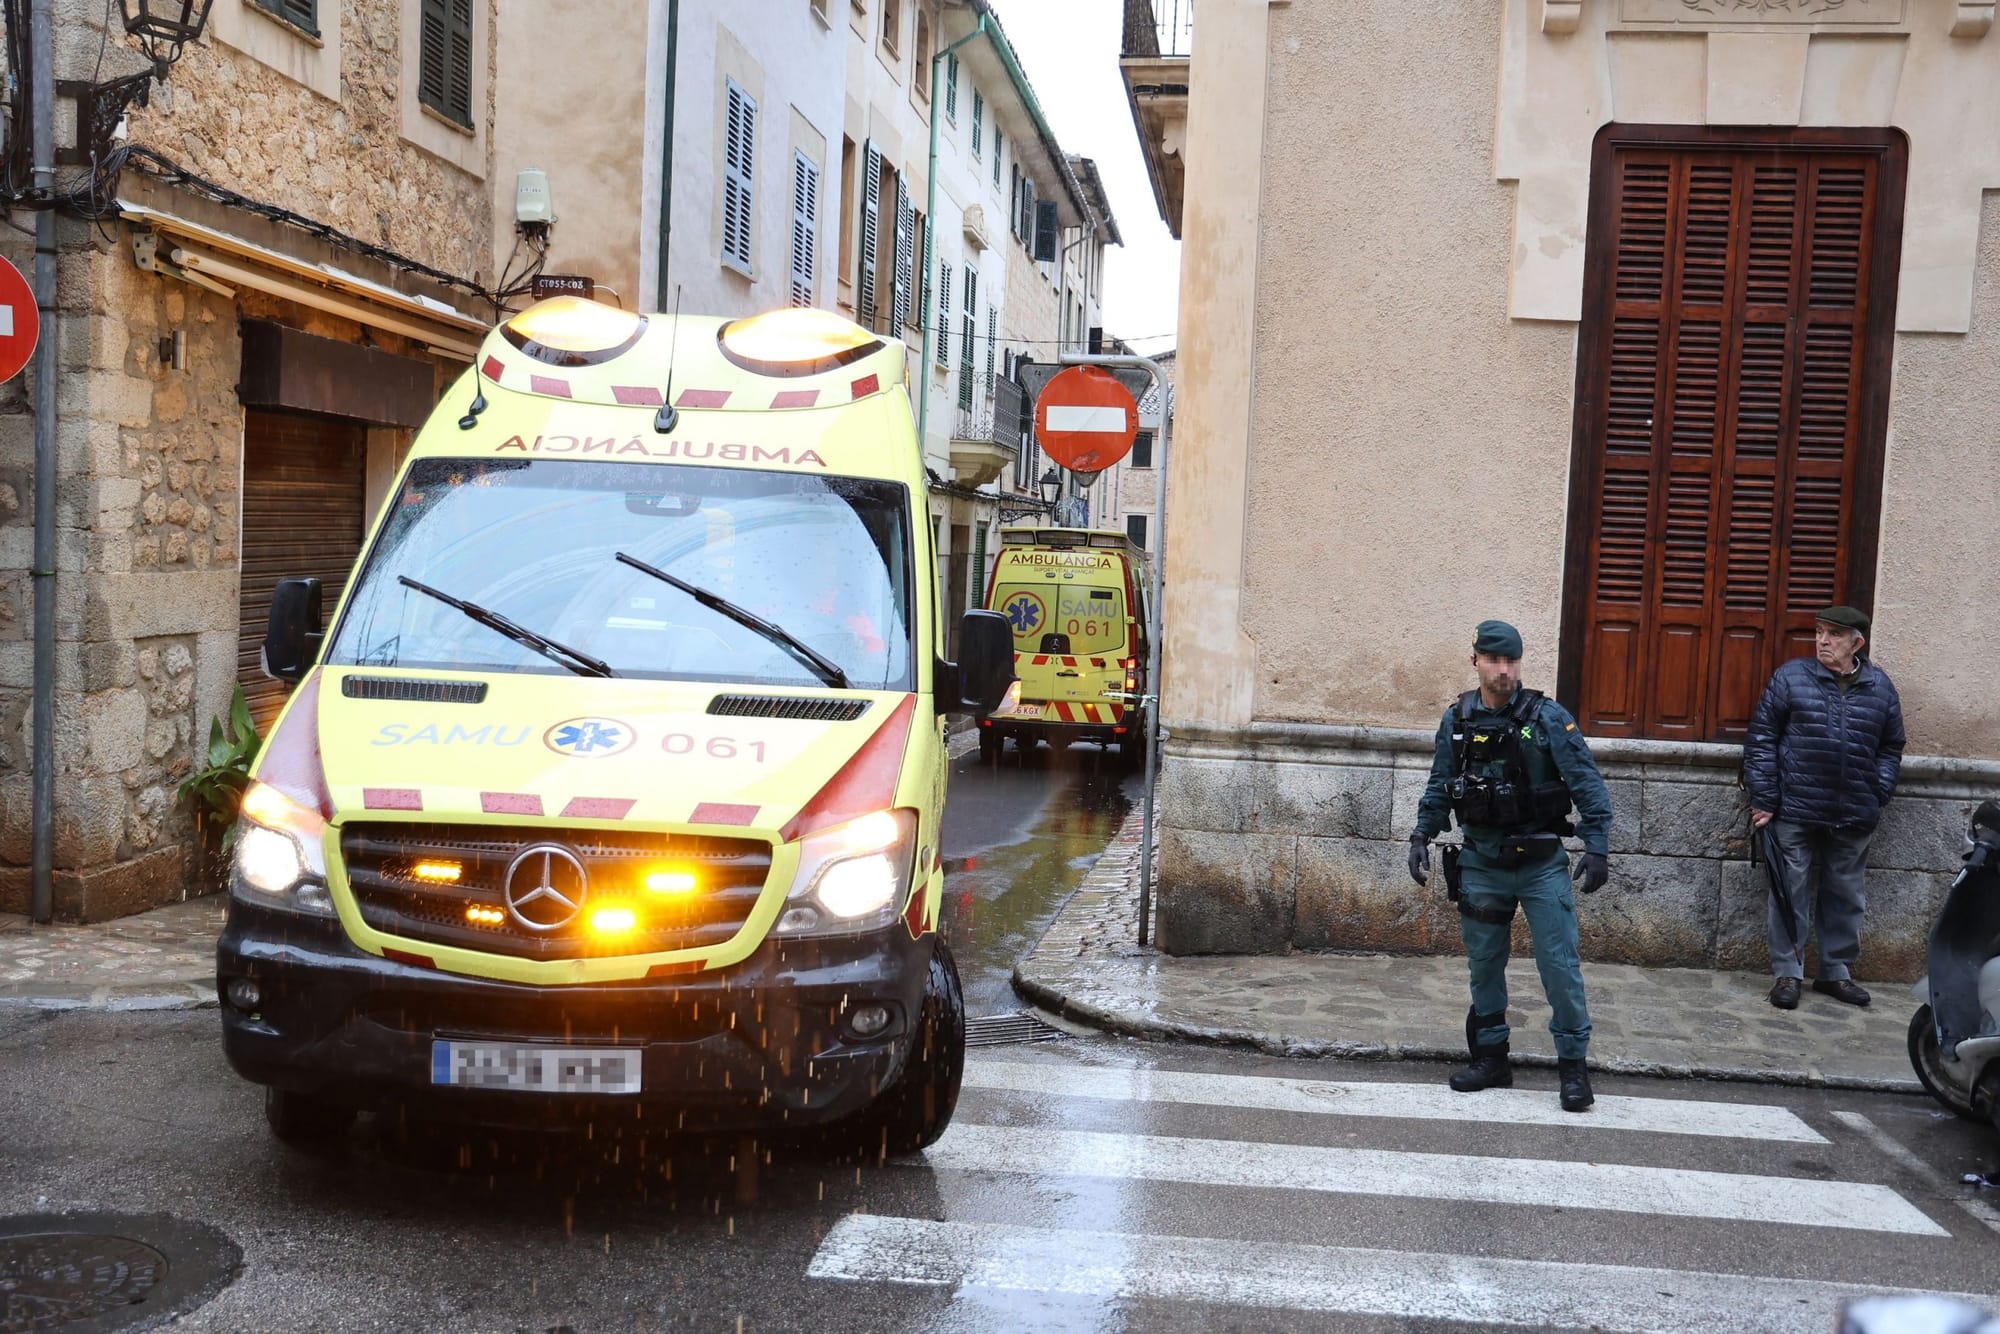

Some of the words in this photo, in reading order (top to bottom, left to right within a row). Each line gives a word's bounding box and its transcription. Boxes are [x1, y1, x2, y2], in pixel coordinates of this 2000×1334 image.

[1061, 600, 1117, 617] SAMU
[1067, 619, 1109, 637] 061
[371, 724, 532, 746] SAMU
[661, 733, 766, 763] 061
